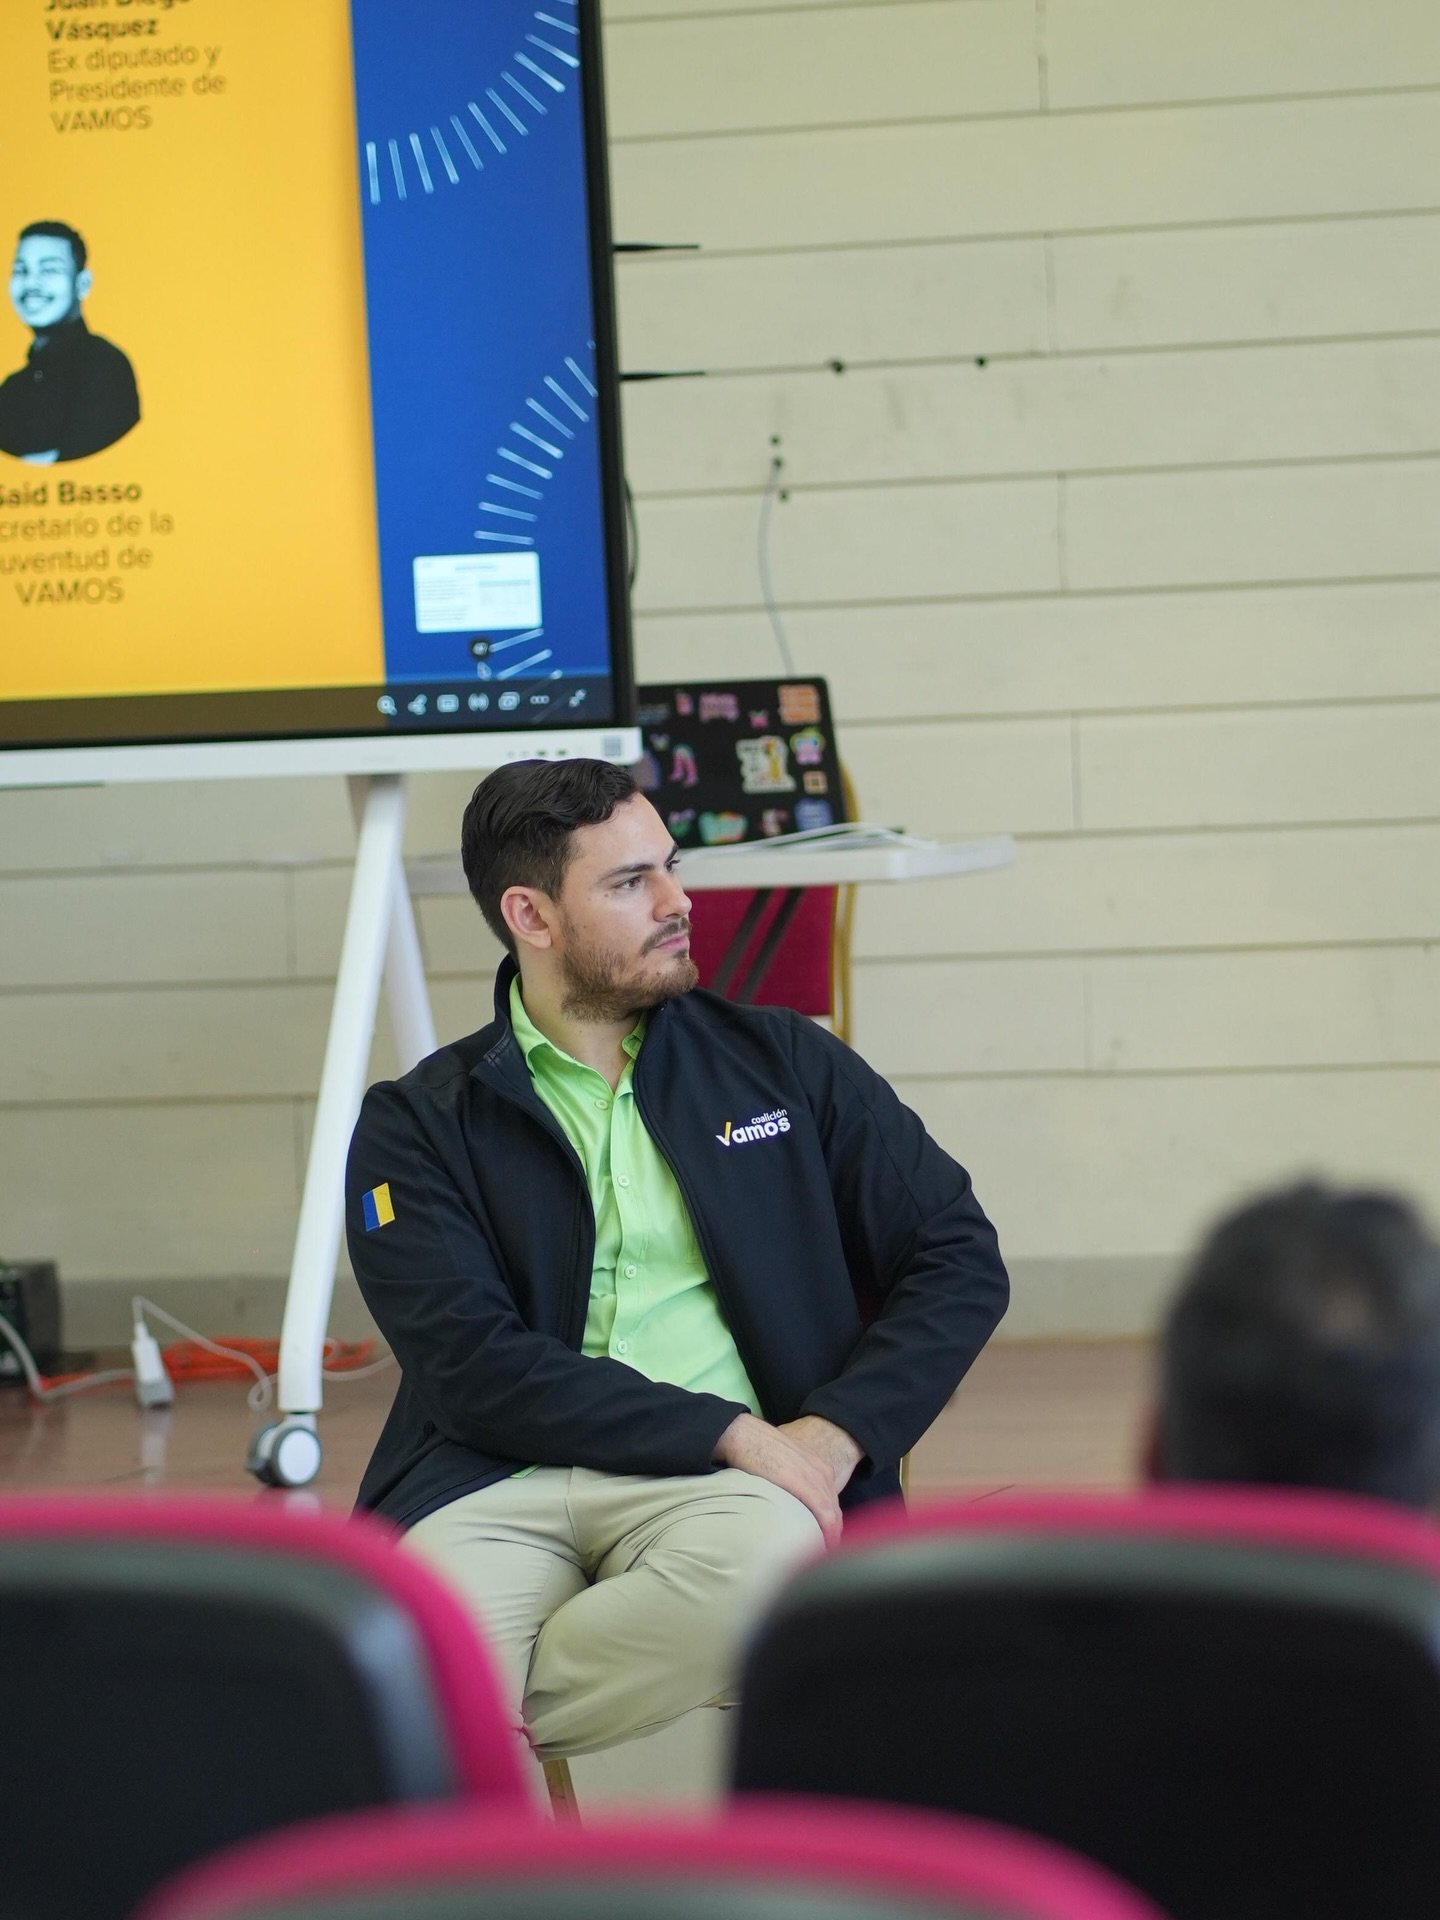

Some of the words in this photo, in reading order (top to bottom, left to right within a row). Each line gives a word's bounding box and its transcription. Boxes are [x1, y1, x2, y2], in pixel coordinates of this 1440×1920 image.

[49, 49, 77, 73] Ex
[86, 45, 197, 71] diputado
[204, 46, 222, 68] y
[50, 76, 187, 103] Presidente
[192, 73, 227, 96] de
[51, 105, 153, 134] VAMOS
[58, 480, 142, 505] Basso
[106, 511, 142, 537] de
[150, 508, 175, 535] la
[117, 544, 153, 569] de
[15, 575, 124, 605] VAMOS
[751, 1108, 788, 1125] coalición
